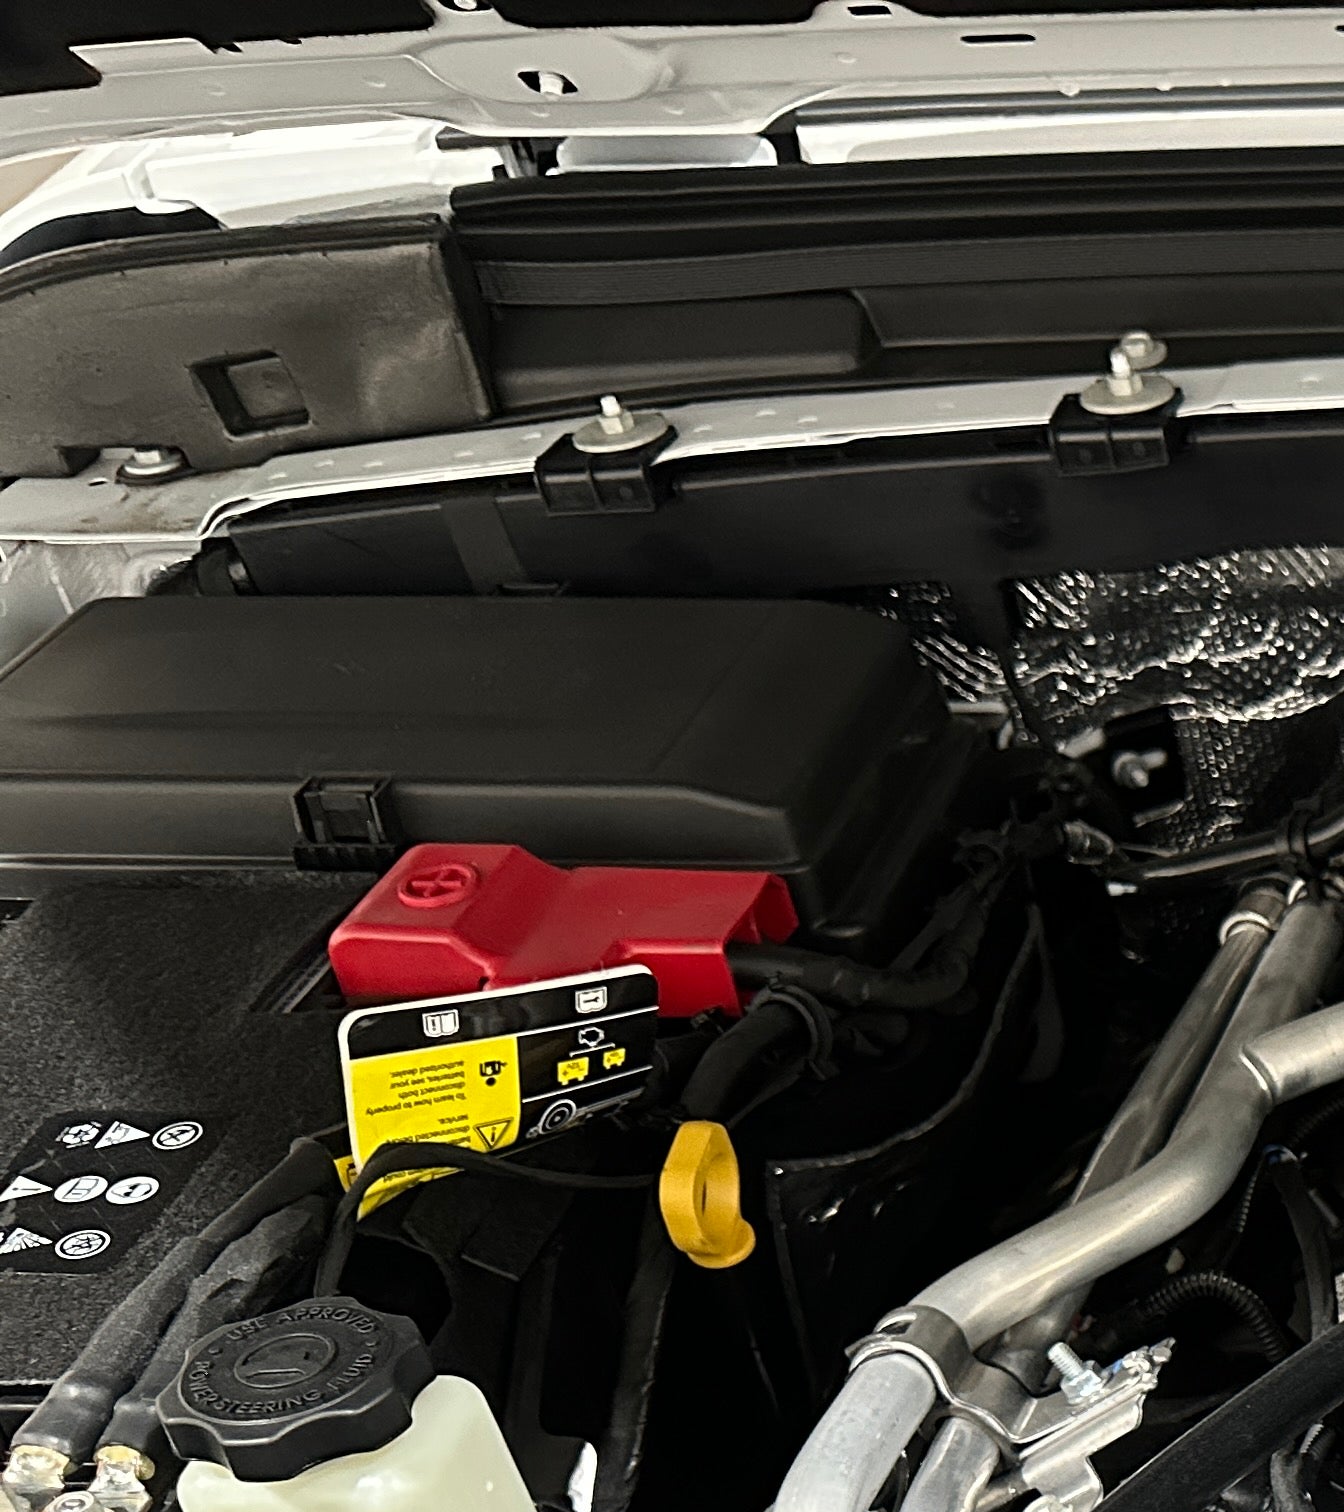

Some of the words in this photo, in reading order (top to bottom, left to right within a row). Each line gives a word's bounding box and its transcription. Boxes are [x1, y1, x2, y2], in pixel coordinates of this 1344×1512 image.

[226, 1318, 268, 1342] USE
[276, 1306, 378, 1335] APPROVED
[215, 1388, 322, 1413] STEERING
